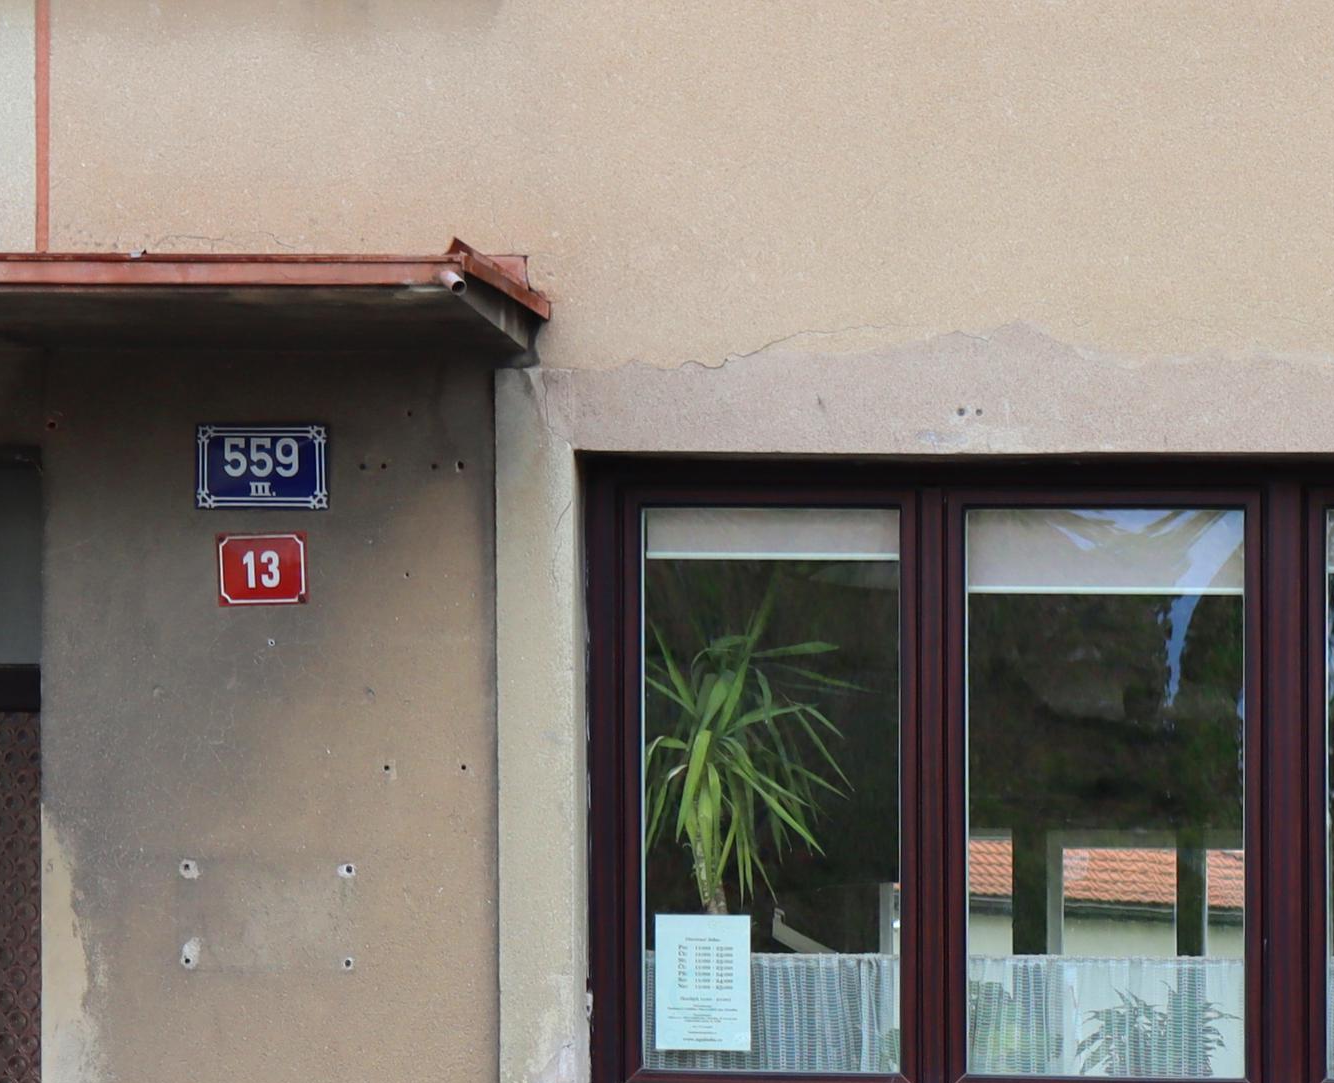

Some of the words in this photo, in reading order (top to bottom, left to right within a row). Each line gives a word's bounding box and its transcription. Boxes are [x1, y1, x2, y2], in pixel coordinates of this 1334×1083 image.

[223, 437, 300, 478] 559
[249, 481, 277, 497] III.
[242, 550, 281, 589] 13
